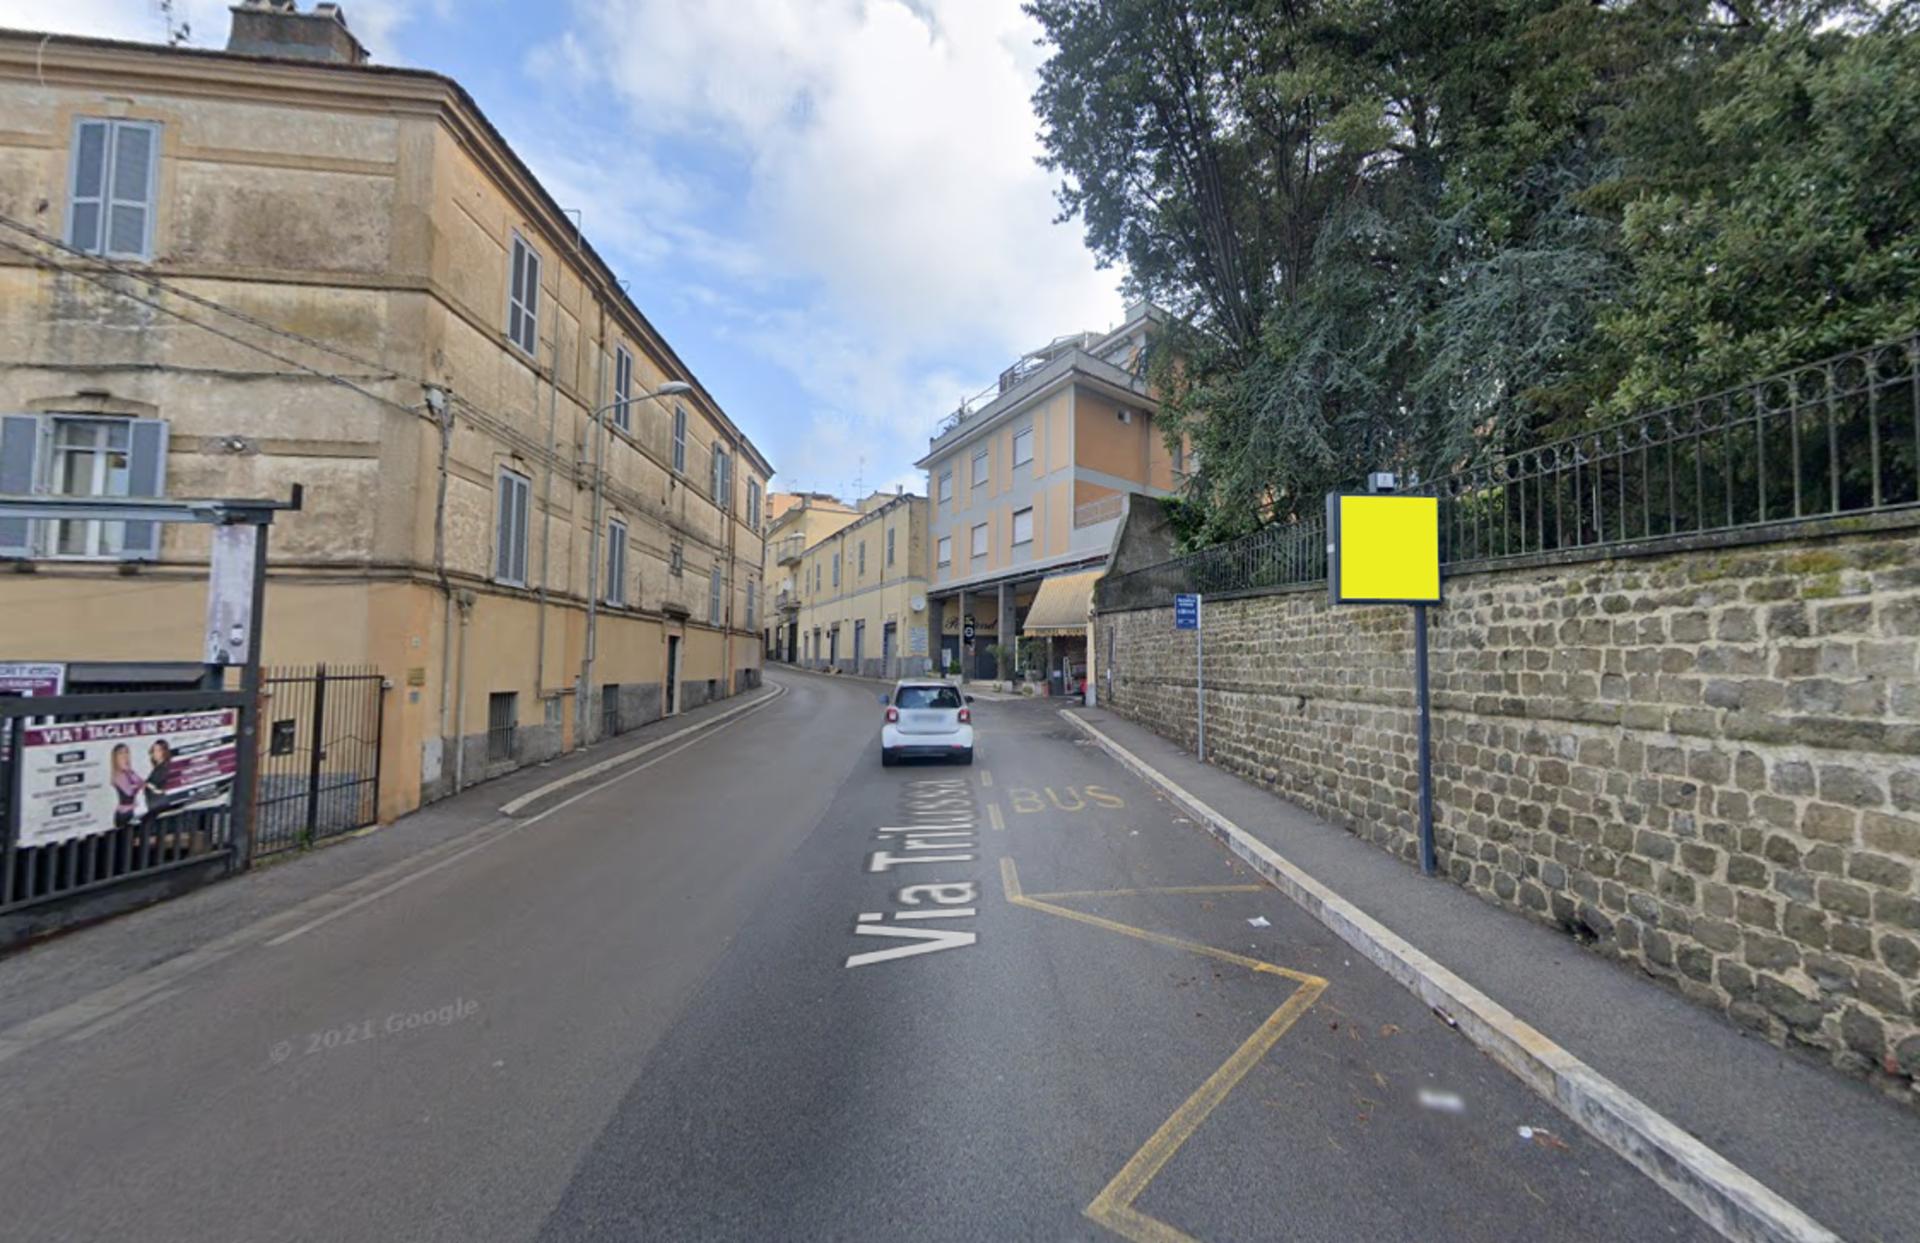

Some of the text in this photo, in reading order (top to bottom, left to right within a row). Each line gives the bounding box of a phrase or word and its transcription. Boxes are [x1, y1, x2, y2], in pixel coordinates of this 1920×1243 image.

[42, 729, 74, 744] VIA
[87, 723, 138, 740] TAGLIA
[141, 719, 157, 735] IN
[1010, 785, 1125, 813] BUS
